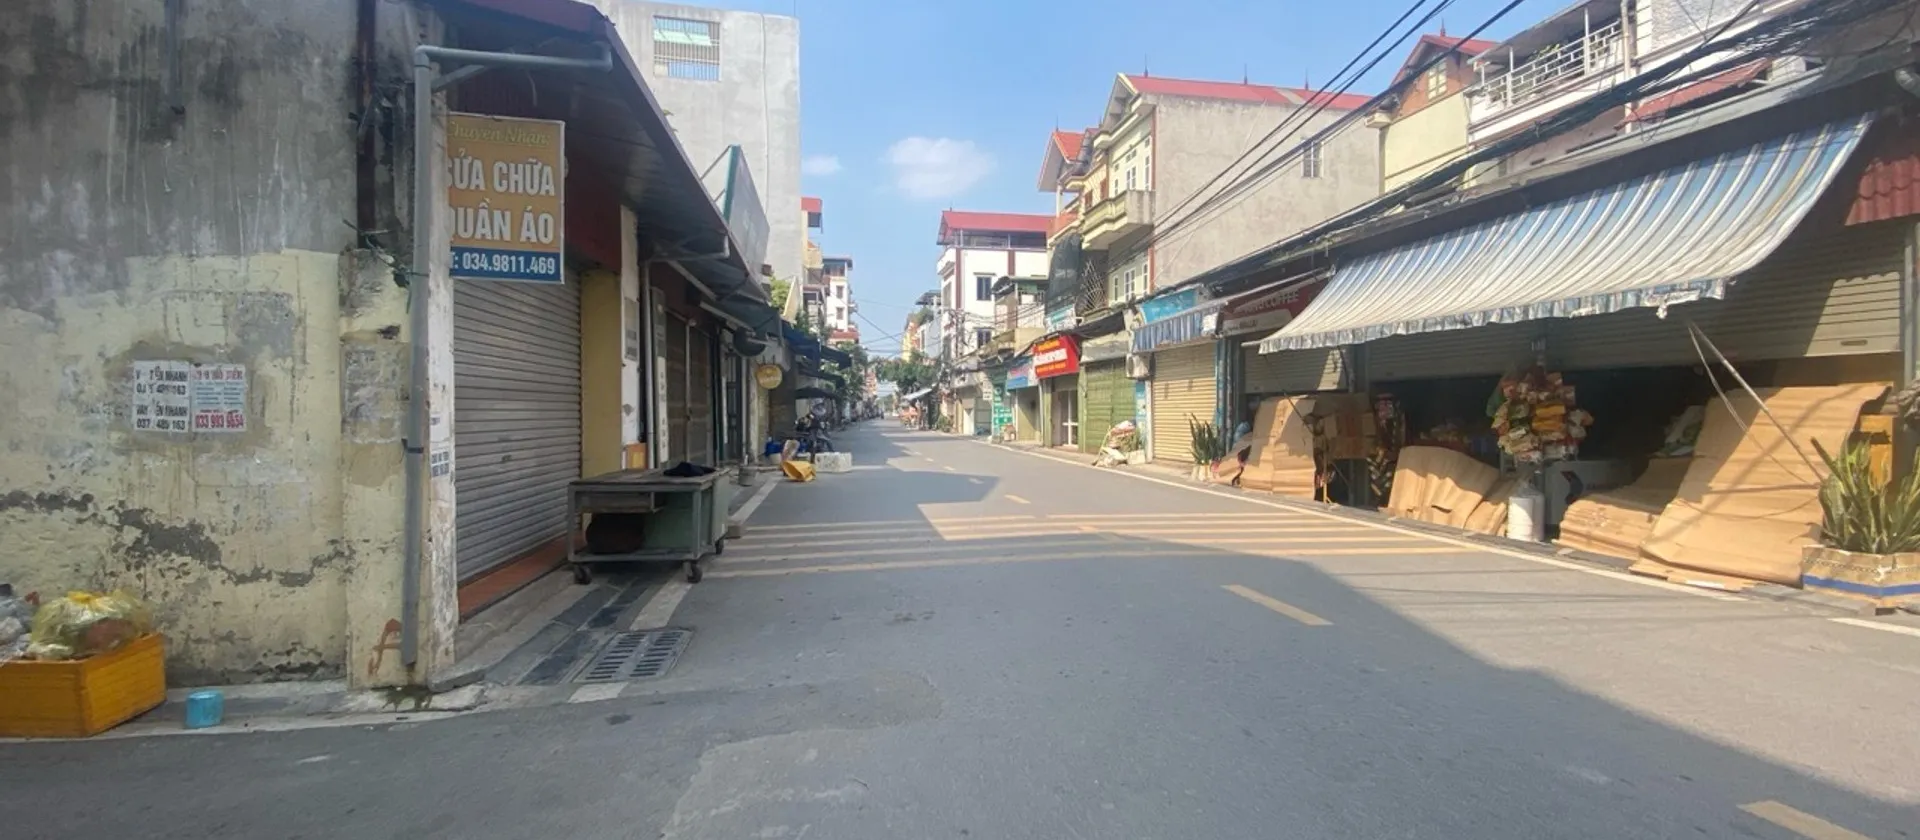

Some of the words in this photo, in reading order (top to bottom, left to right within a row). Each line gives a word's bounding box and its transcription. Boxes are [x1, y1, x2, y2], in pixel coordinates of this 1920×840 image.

[493, 157, 556, 197] CHỮA
[520, 205, 555, 245] ÁO
[462, 251, 556, 275] 034.9811.469
[137, 418, 151, 429] 037
